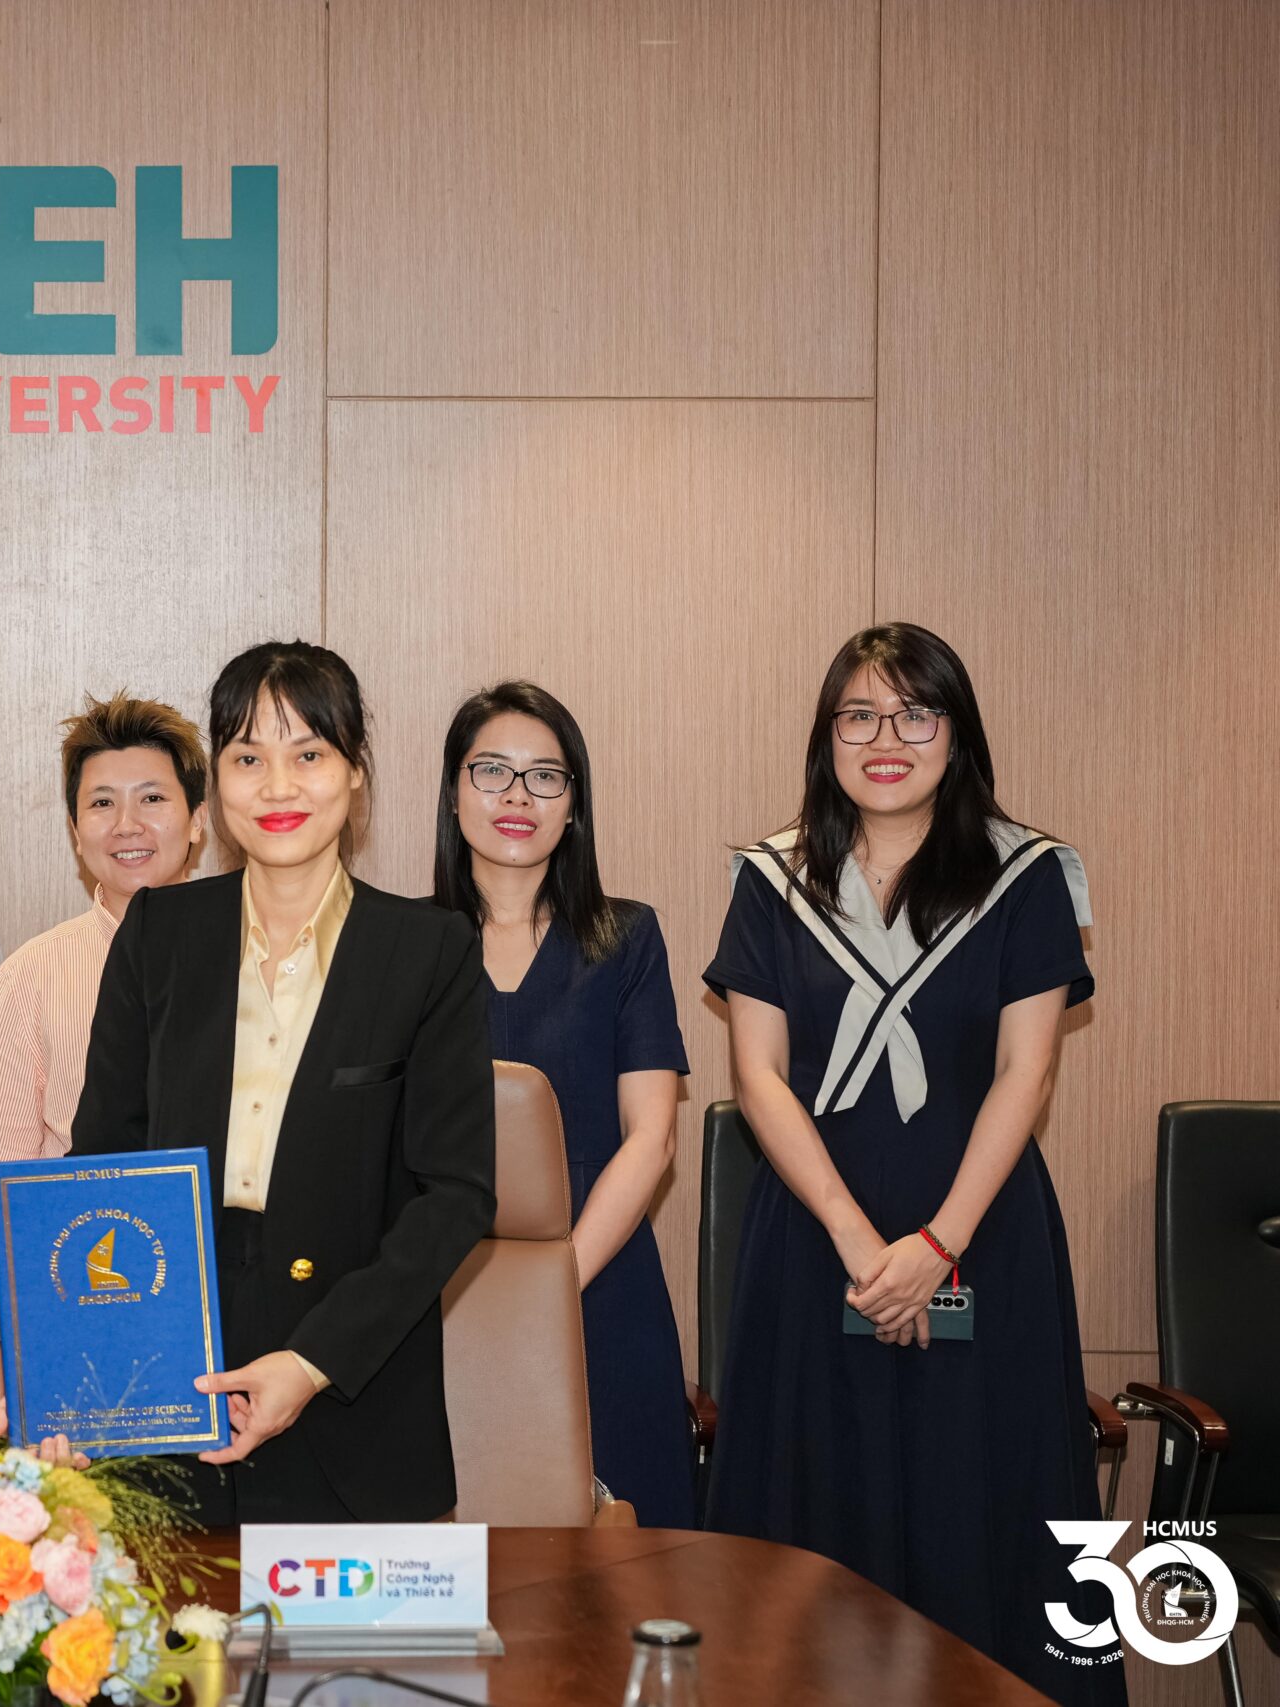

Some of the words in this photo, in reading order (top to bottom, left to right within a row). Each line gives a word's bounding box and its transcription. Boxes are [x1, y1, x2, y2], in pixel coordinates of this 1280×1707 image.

[75, 1167, 122, 1181] HCMUS
[96, 1209, 131, 1222] KHOA
[155, 1404, 193, 1415] SCIENCE
[386, 1559, 430, 1571] Trường
[268, 1559, 374, 1598] CTD
[386, 1572, 418, 1585] Công
[423, 1572, 455, 1585] Nghệ
[386, 1587, 400, 1598] và
[404, 1586, 435, 1598] Thiết
